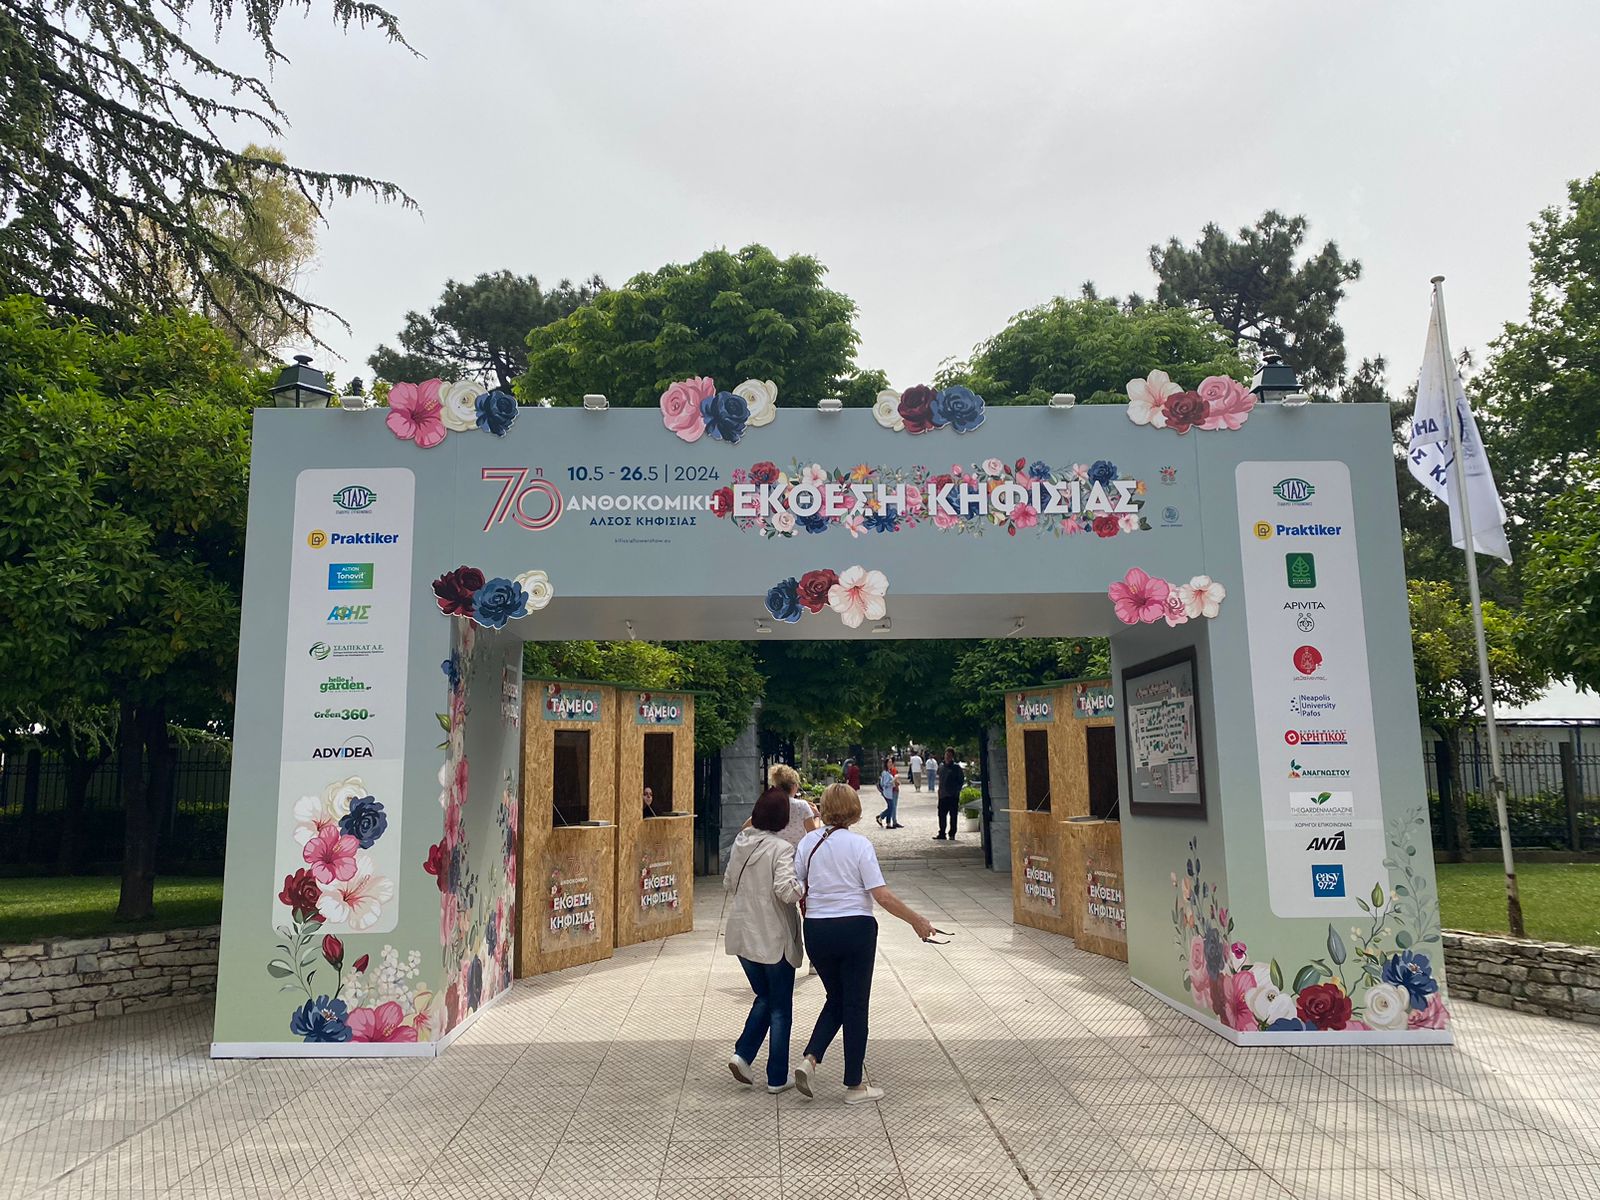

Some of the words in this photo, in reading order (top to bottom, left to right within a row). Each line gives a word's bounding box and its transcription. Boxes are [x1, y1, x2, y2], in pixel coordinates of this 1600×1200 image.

[567, 466, 604, 481] 10.5
[620, 466, 659, 481] 26.5
[674, 466, 720, 481] 2024
[566, 494, 720, 511] ΑΝΘΟΚΟΜΙΚΗ
[733, 483, 902, 517] ΕΚΘΕΣΗ
[927, 480, 1139, 515] ΚΗΦΙΣΙΑΣ
[589, 516, 632, 526] ΑΛΣΟΣ
[636, 516, 697, 527] ΚΗΦΙΣΙΑΣ
[1276, 524, 1341, 536] Praktiker
[331, 532, 399, 544] Praktiker
[1283, 601, 1326, 610] APIVITA
[551, 698, 594, 714] ΤΑΜΕΙΟ
[1019, 703, 1049, 716] ΤΑΜΕΙΟ
[1080, 694, 1115, 711] ΤΑΜΕΙΟ
[1301, 702, 1336, 710] University
[642, 705, 678, 718] ΤΑΜΕΙΟ
[1300, 732, 1347, 742] ΚΡΗΤΙΚΟΣ
[312, 747, 373, 758] ADVIDEA
[1301, 769, 1350, 777] ΑΝΑΓΝΩΣΤΟΥ
[643, 874, 675, 890] ΕΚΘΕΣΗ
[1026, 867, 1052, 882] ΕΚΘΕΣΗ
[1316, 872, 1340, 883] easy
[641, 889, 678, 907] ΚΗΦΙΣΙΑΣ
[1024, 883, 1055, 899] ΚΗΦΙΣΙΑΣ
[1090, 884, 1121, 903] ΕΚΘΕΣΗ
[553, 892, 592, 911] ΕΚΘΕΣΗ
[1088, 902, 1125, 921] ΚΗΦΙΣΙΑΣ
[550, 910, 595, 930] ΚΗΦΙΣΙΑΣ
